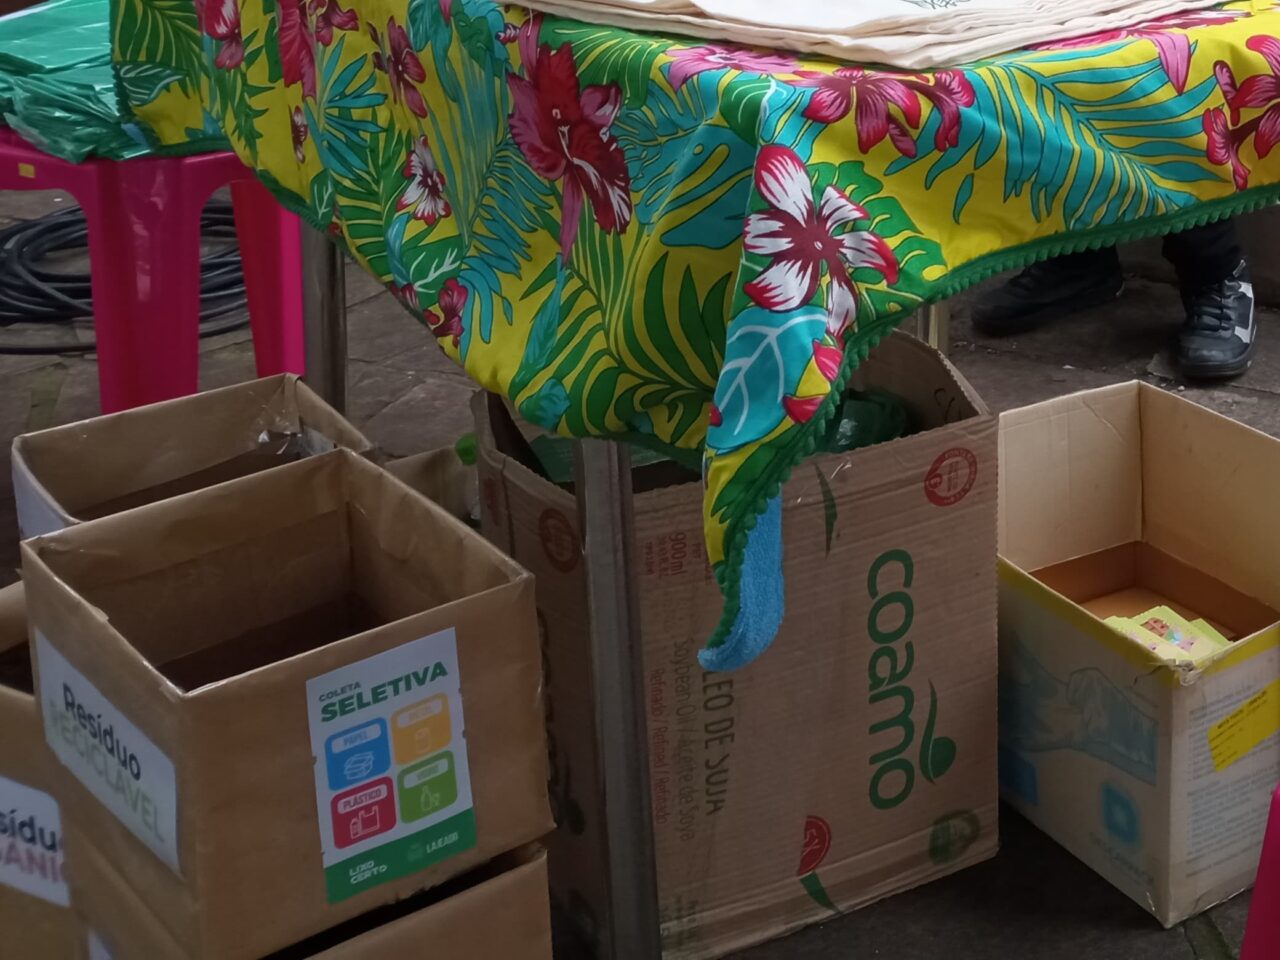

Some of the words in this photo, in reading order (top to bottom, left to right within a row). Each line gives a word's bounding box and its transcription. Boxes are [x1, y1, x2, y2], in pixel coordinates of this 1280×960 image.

[668, 532, 688, 576] 900ml
[318, 681, 363, 703] COLETA
[320, 660, 449, 723] SELETIVA
[702, 671, 734, 712] LEO
[866, 549, 916, 810] coamo
[62, 682, 142, 782] Resíduo
[704, 717, 736, 750] DE
